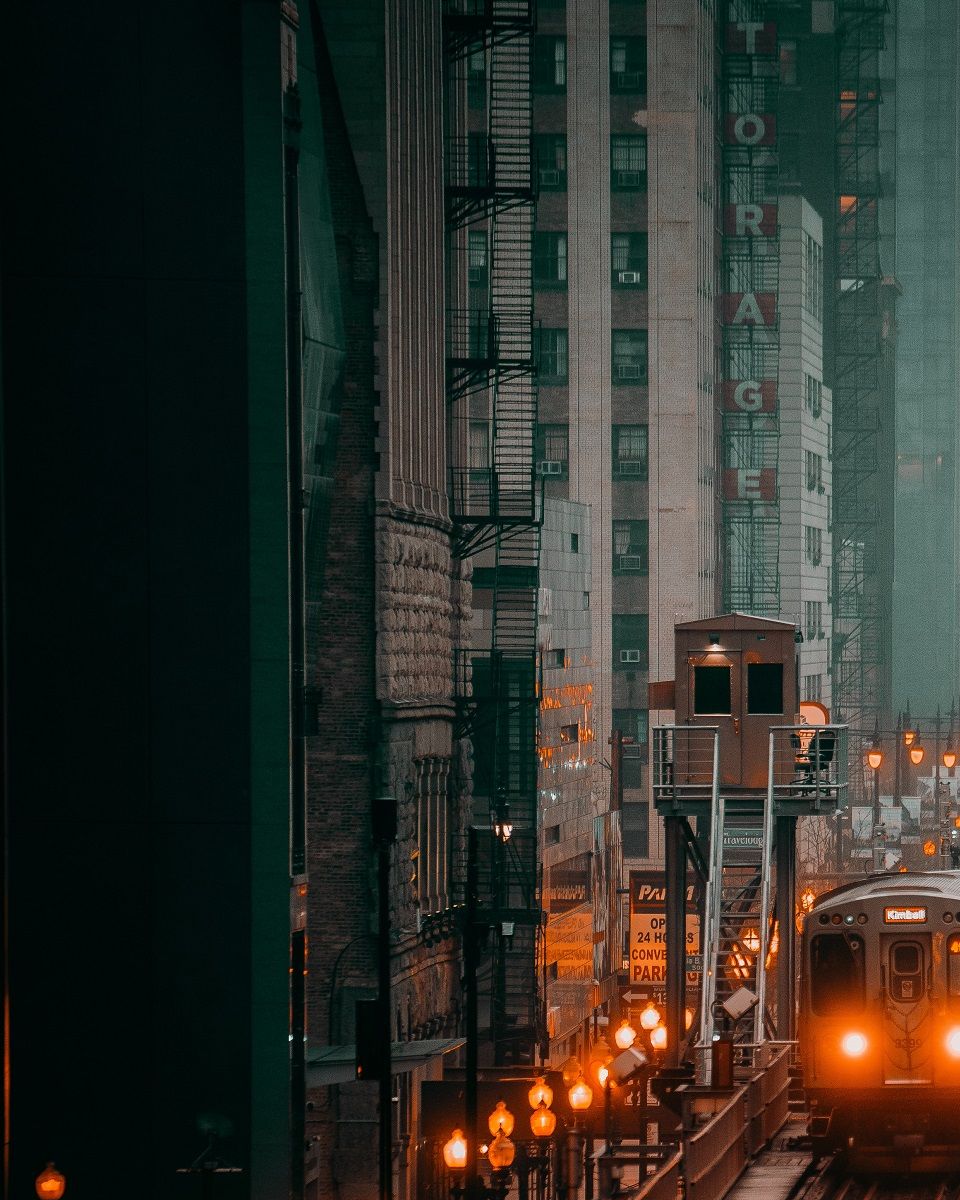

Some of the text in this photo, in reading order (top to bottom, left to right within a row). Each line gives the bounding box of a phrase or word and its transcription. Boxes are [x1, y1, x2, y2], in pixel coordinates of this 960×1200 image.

[723, 831, 764, 848] Travelodg
[887, 909, 927, 920] Kimball
[650, 918, 667, 929] OP
[637, 931, 650, 943] 24
[633, 965, 699, 982] PARG
